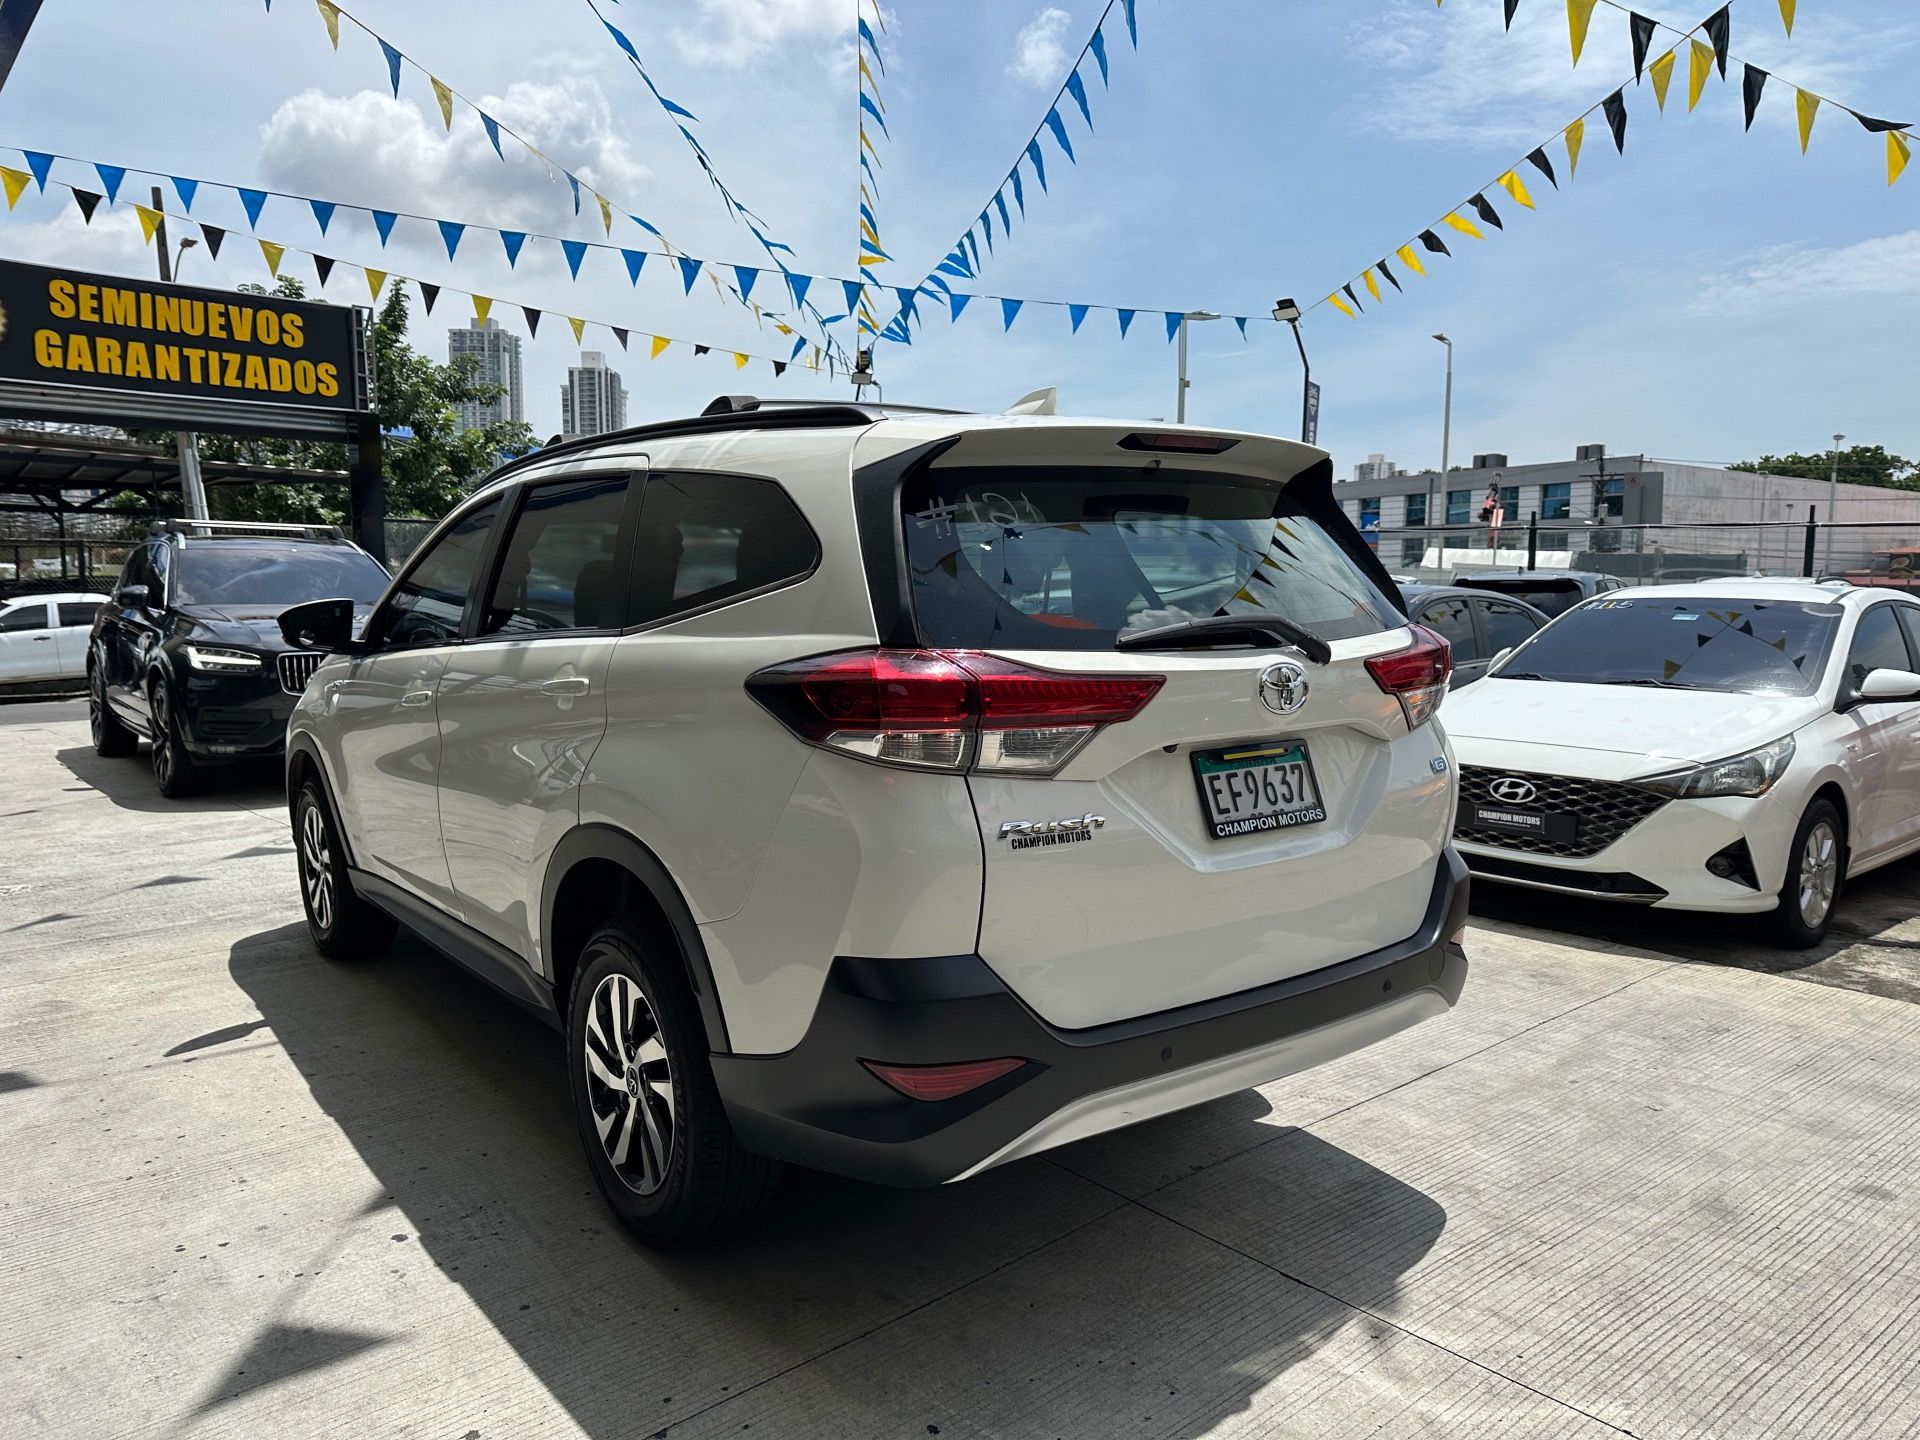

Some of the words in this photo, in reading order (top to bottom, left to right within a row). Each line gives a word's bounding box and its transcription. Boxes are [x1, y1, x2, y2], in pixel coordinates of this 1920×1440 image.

[49, 278, 304, 349] SEMINUEVOS
[33, 328, 339, 397] GARANTIZADOS
[1207, 762, 1305, 815] EF9637
[998, 812, 1106, 840] Rush
[1216, 818, 1277, 836] CHAMPION
[1279, 808, 1324, 826] MOTORS
[1478, 809, 1512, 822] CHAMPION
[1512, 813, 1541, 826] MOTORS
[1011, 834, 1056, 850] CHAMPION
[1057, 830, 1092, 845] MOTORS
